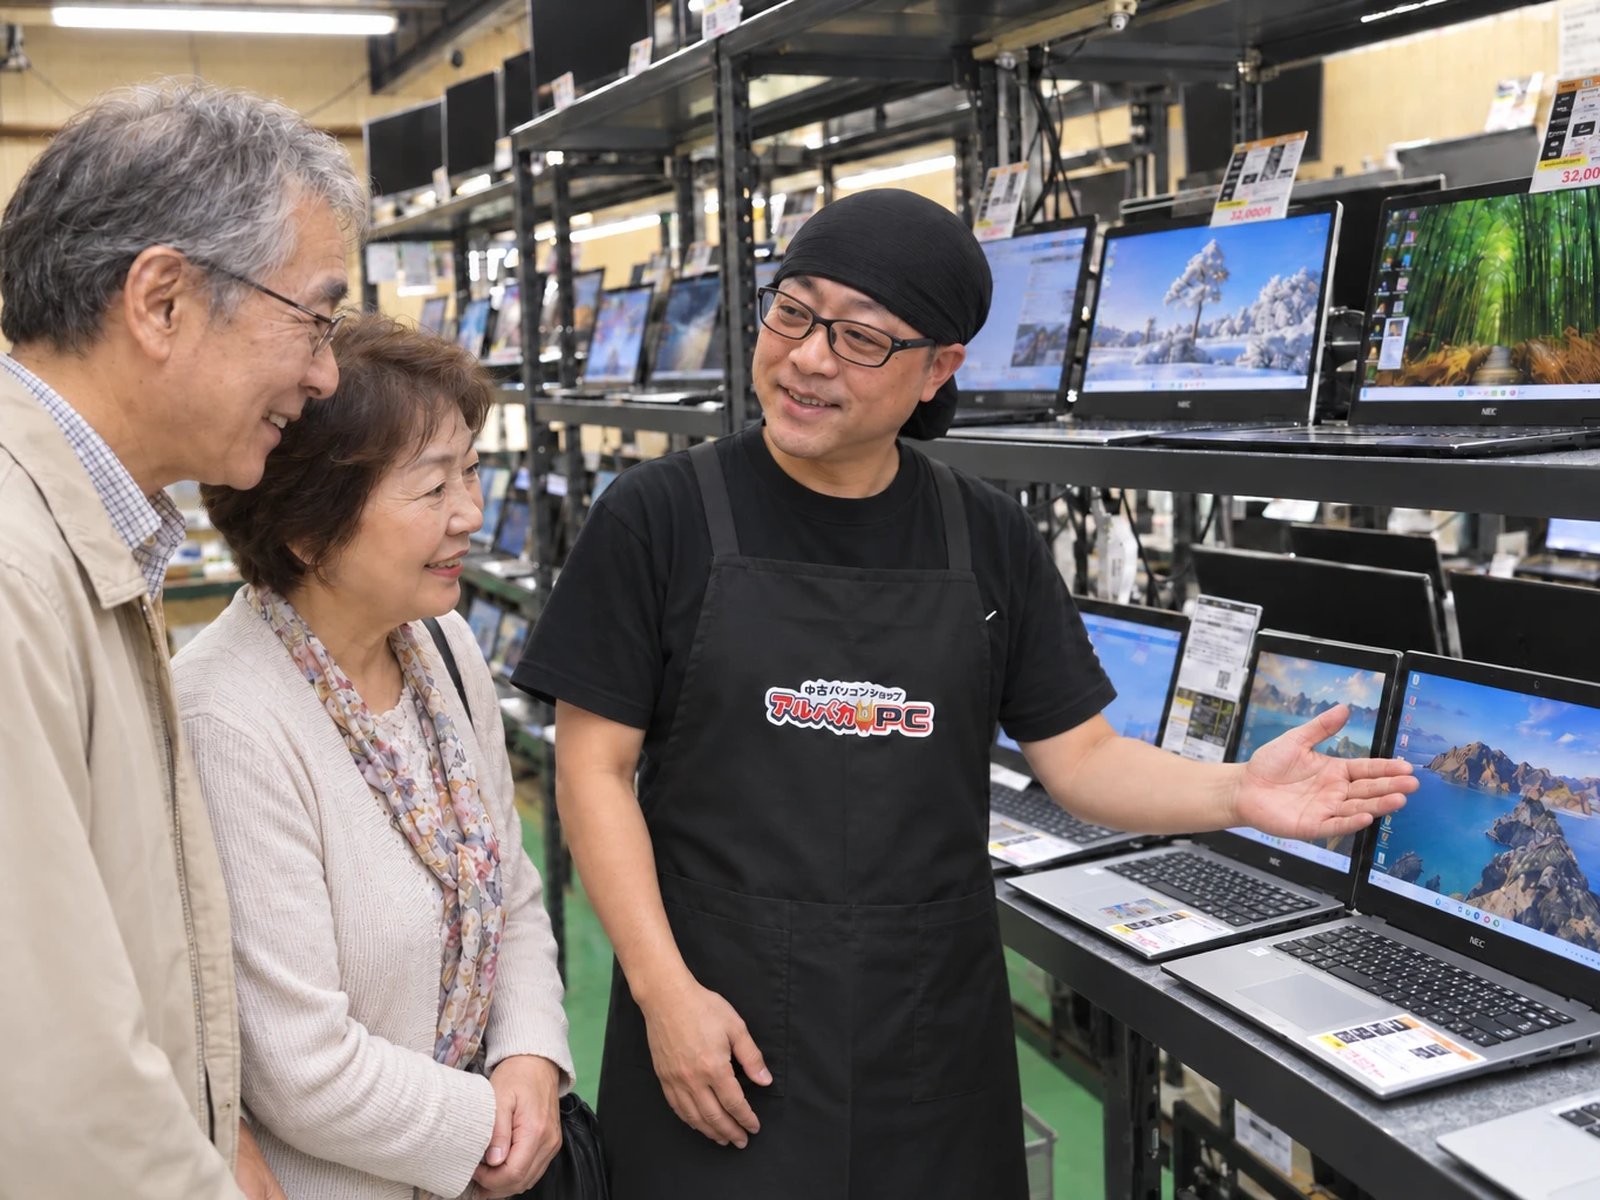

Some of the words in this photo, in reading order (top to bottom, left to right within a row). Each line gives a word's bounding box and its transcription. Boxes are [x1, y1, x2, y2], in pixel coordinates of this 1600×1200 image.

[1561, 166, 1600, 184] 32,00
[1481, 407, 1497, 416] NEC
[1469, 935, 1486, 949] NEC
